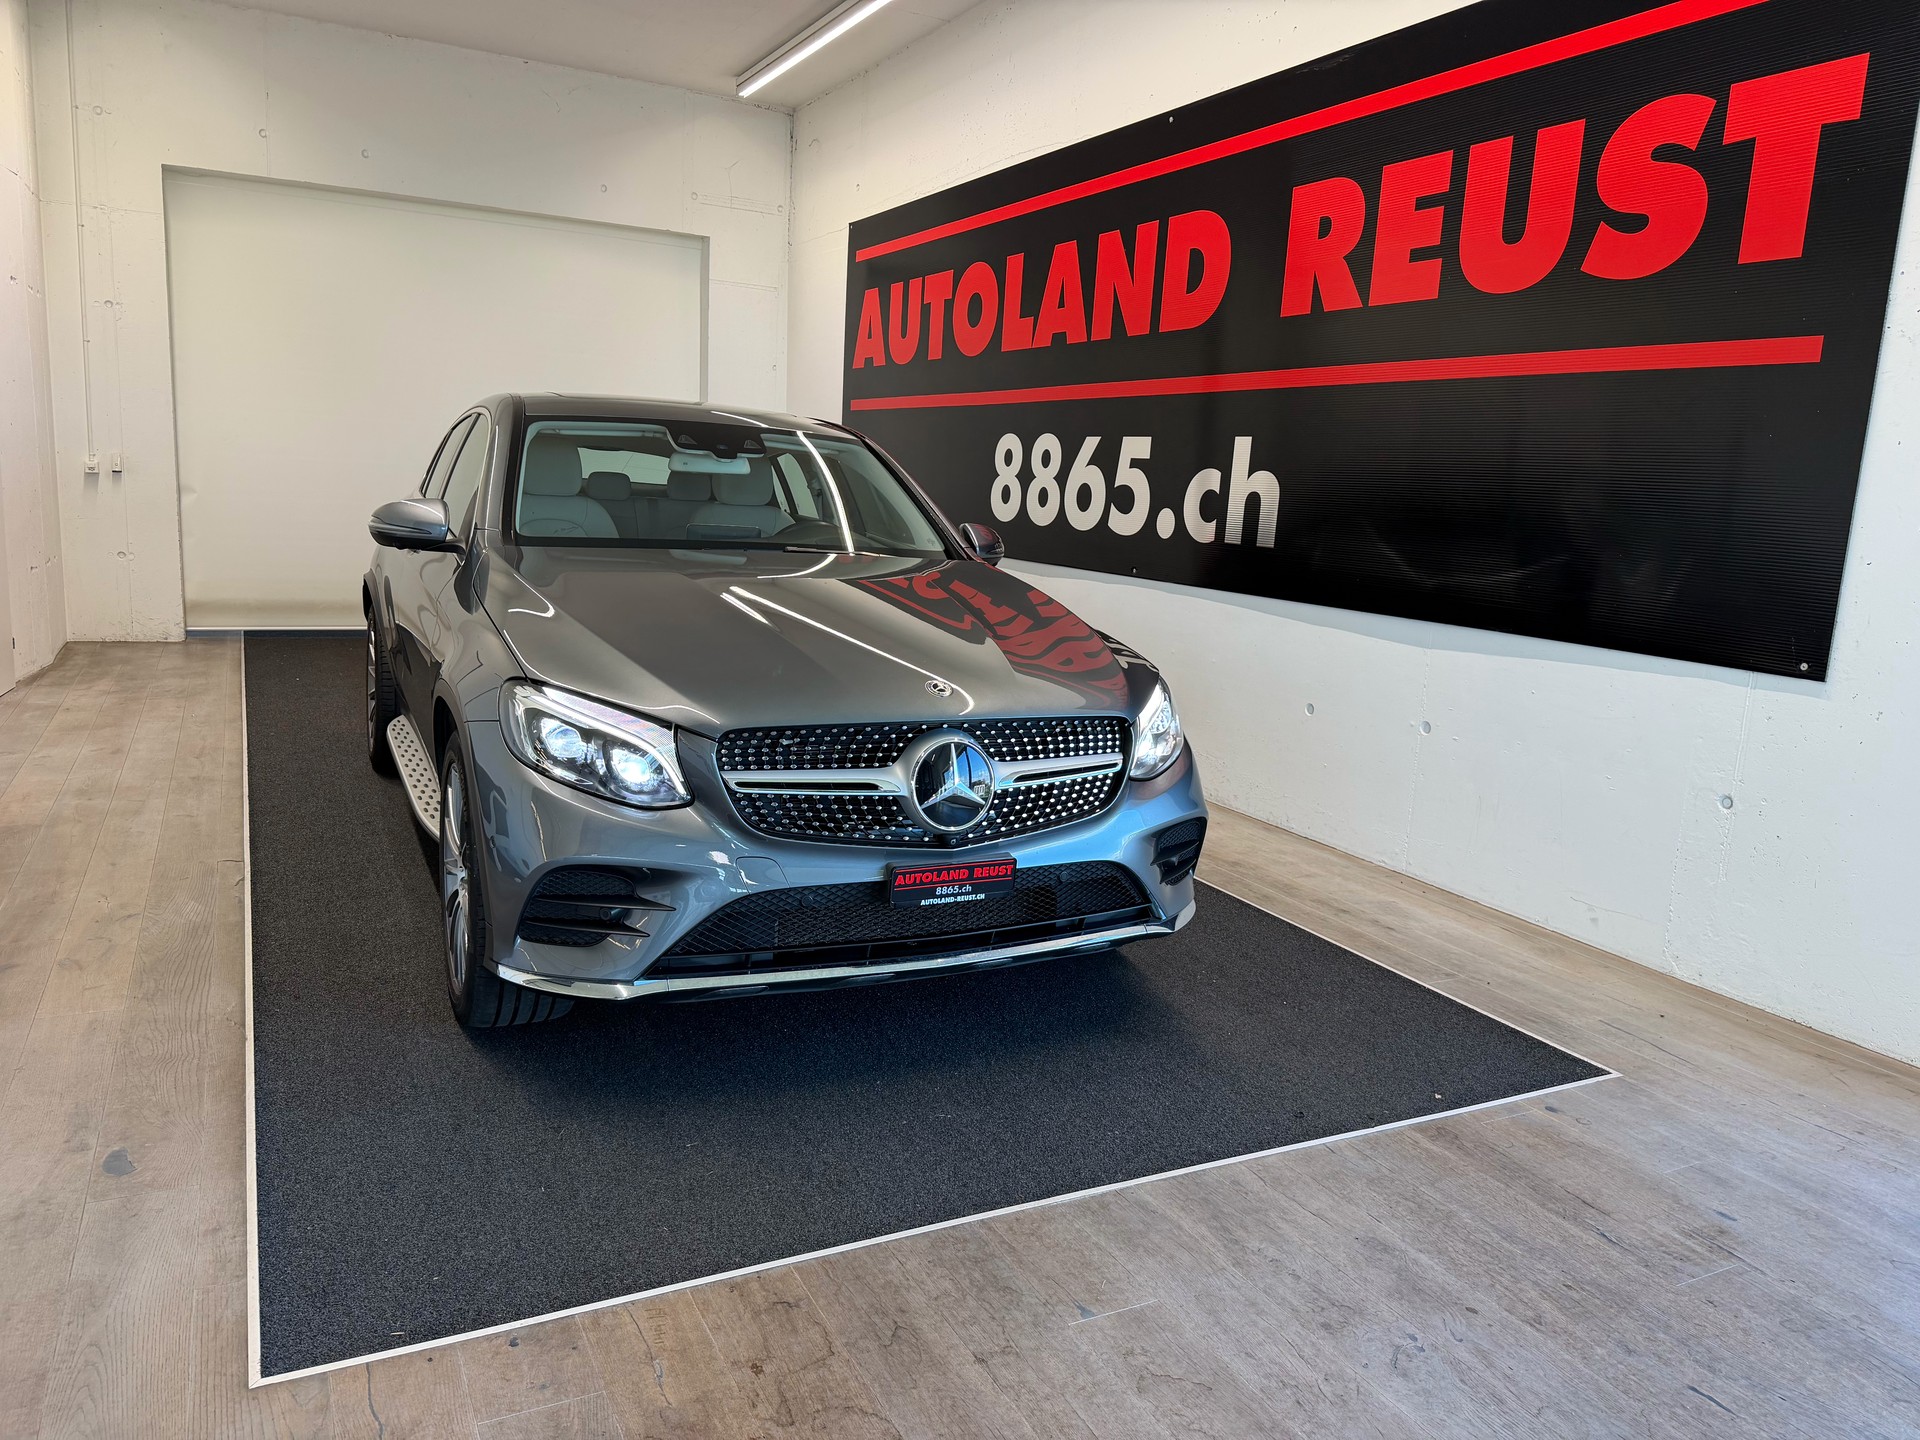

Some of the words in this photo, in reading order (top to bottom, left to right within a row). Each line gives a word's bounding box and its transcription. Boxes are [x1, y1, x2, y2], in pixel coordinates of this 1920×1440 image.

[853, 209, 1232, 369] AUTOLAND
[1281, 52, 1870, 318] REUST
[990, 433, 1281, 548] 8865.ch
[895, 869, 969, 885] AUTOLAND
[973, 865, 1013, 877] REUST
[920, 894, 985, 905] AUTOLAND-REUST.CH
[935, 884, 972, 895] 8865.ch
